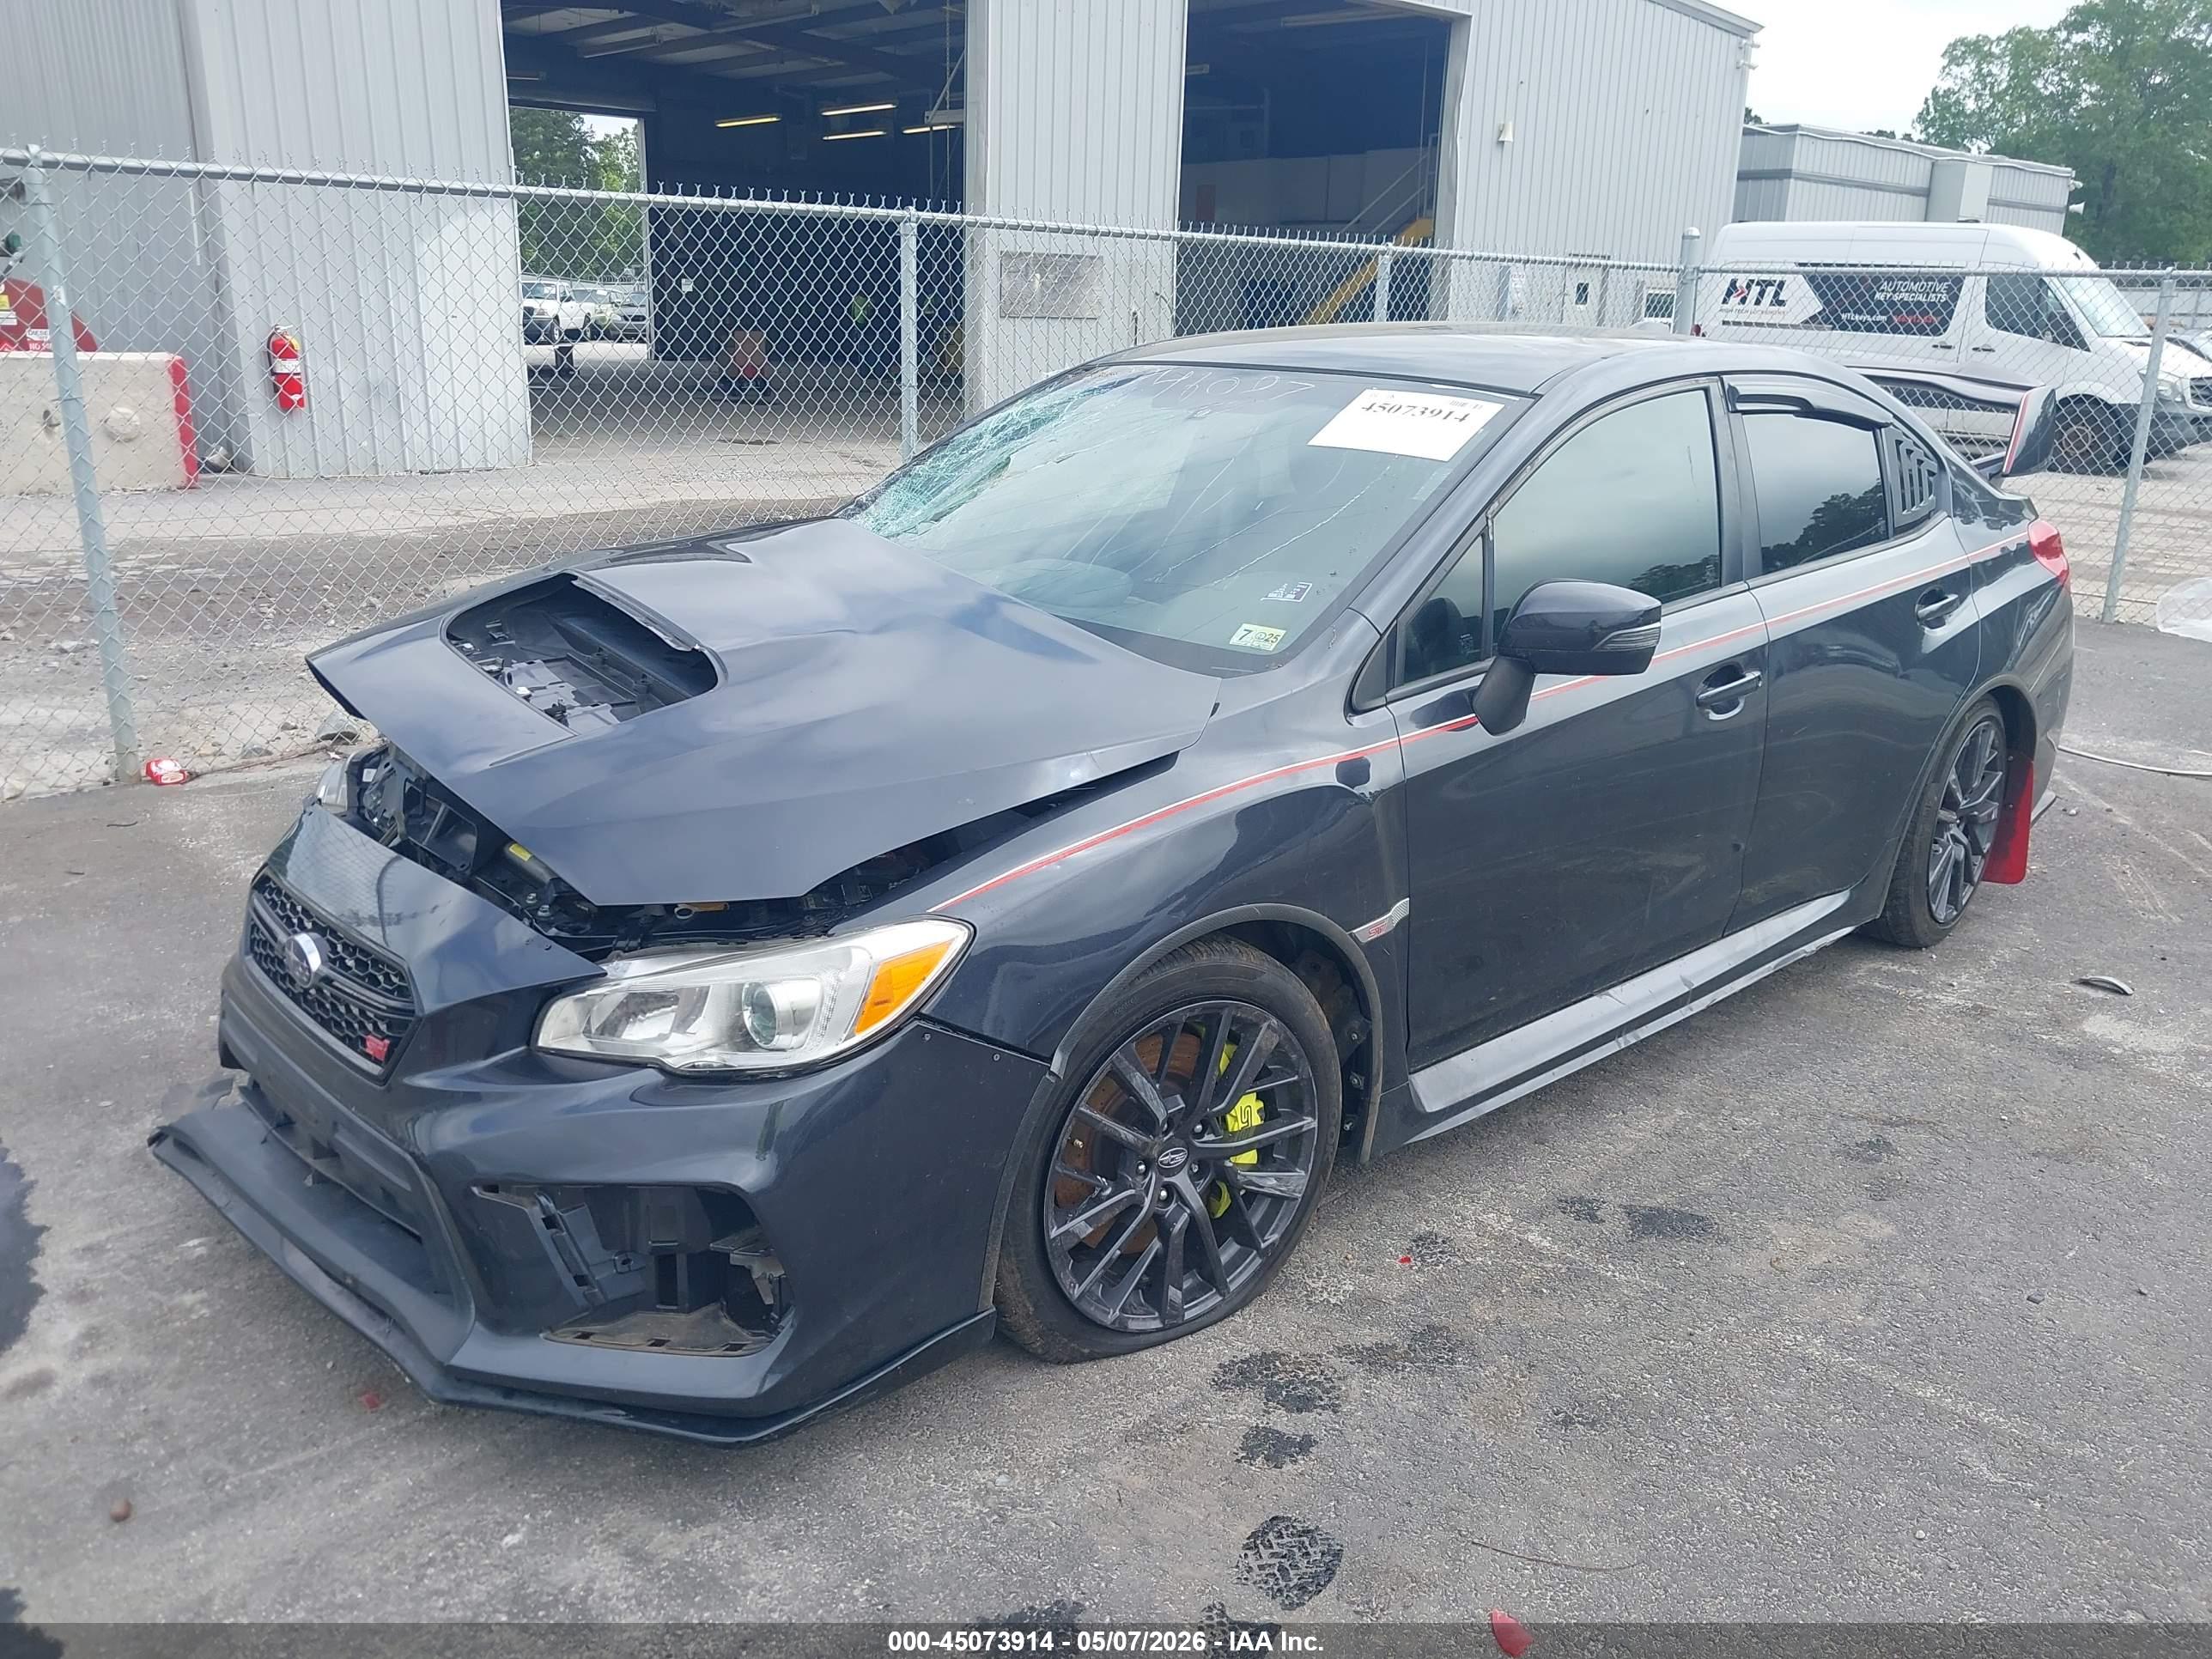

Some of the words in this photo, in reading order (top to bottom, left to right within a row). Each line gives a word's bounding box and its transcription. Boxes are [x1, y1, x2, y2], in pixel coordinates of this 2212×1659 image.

[1721, 278, 1787, 307] HTL
[1879, 280, 1951, 293] AUTOMOTIVE
[1874, 292, 1893, 301] KEY
[1894, 292, 1948, 302] SPECIALISTS
[1361, 401, 1471, 423] 45073914
[1238, 629, 1254, 641] 7
[1263, 633, 1281, 644] 25
